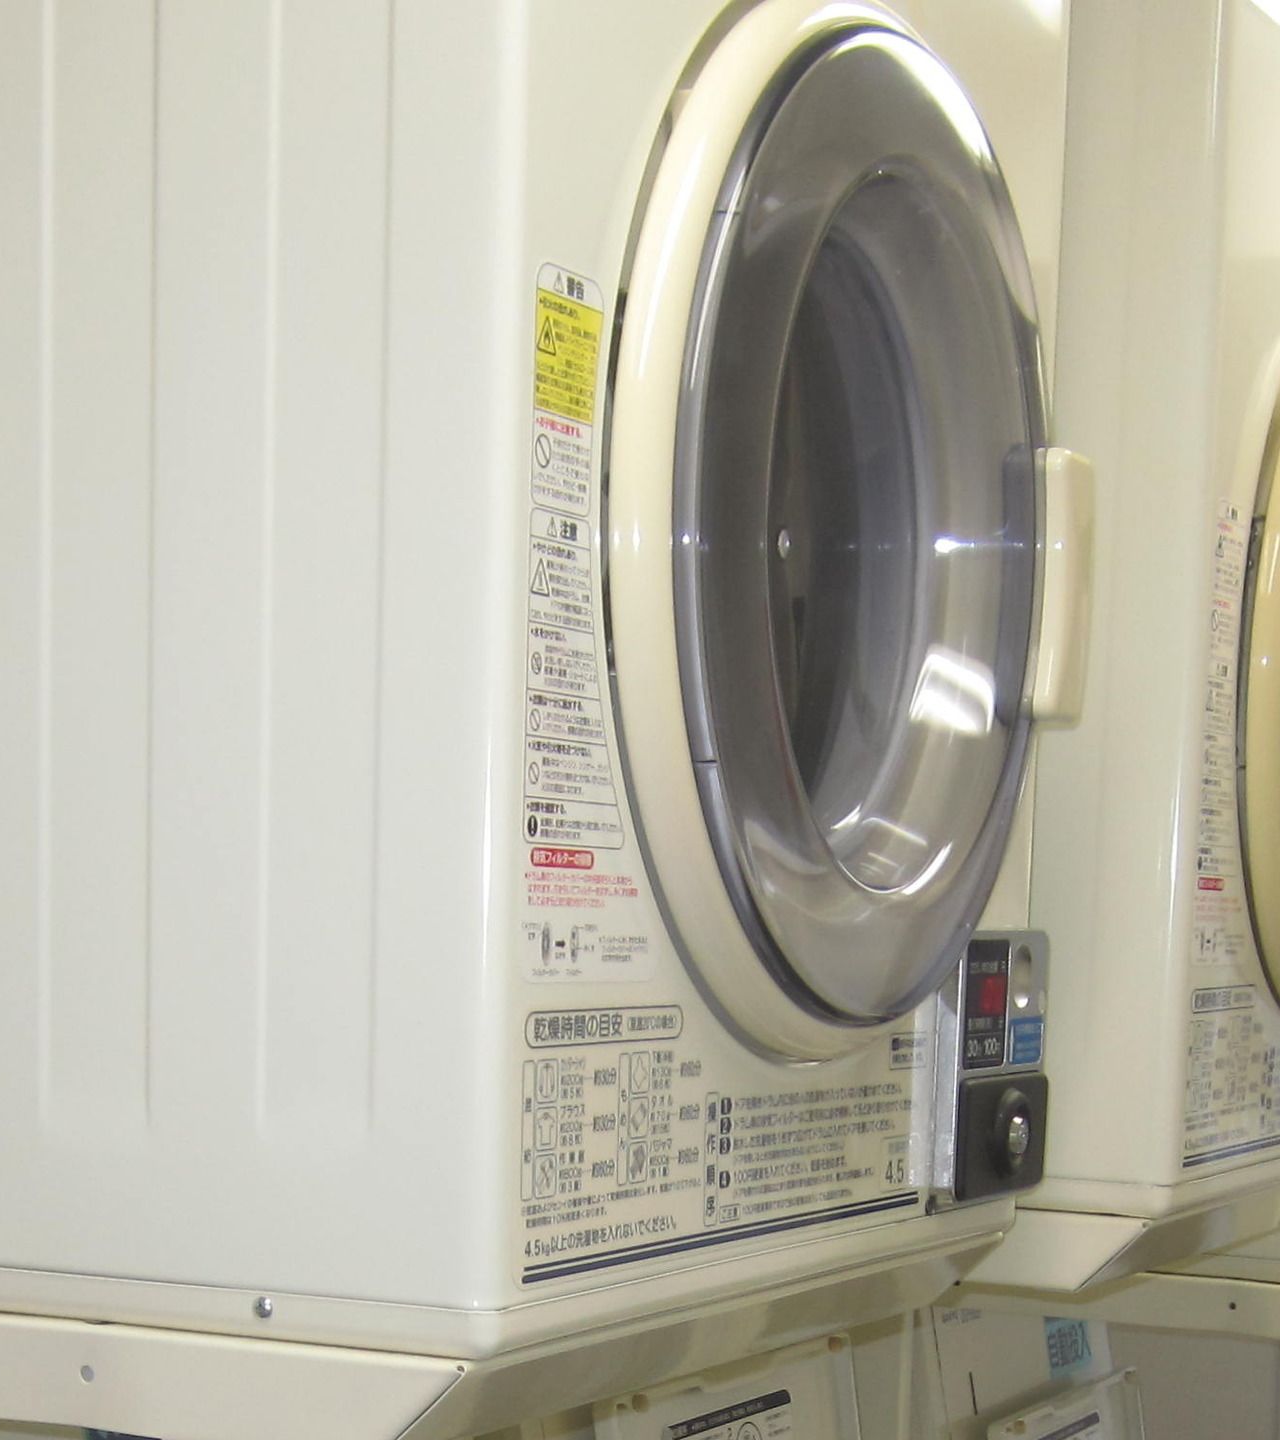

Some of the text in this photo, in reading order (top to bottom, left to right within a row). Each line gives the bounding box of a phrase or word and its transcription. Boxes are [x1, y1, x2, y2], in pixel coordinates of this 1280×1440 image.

[560, 519, 577, 541] 注意
[534, 1013, 623, 1041] 乾燥時間の目安
[885, 1158, 905, 1184] 4.5
